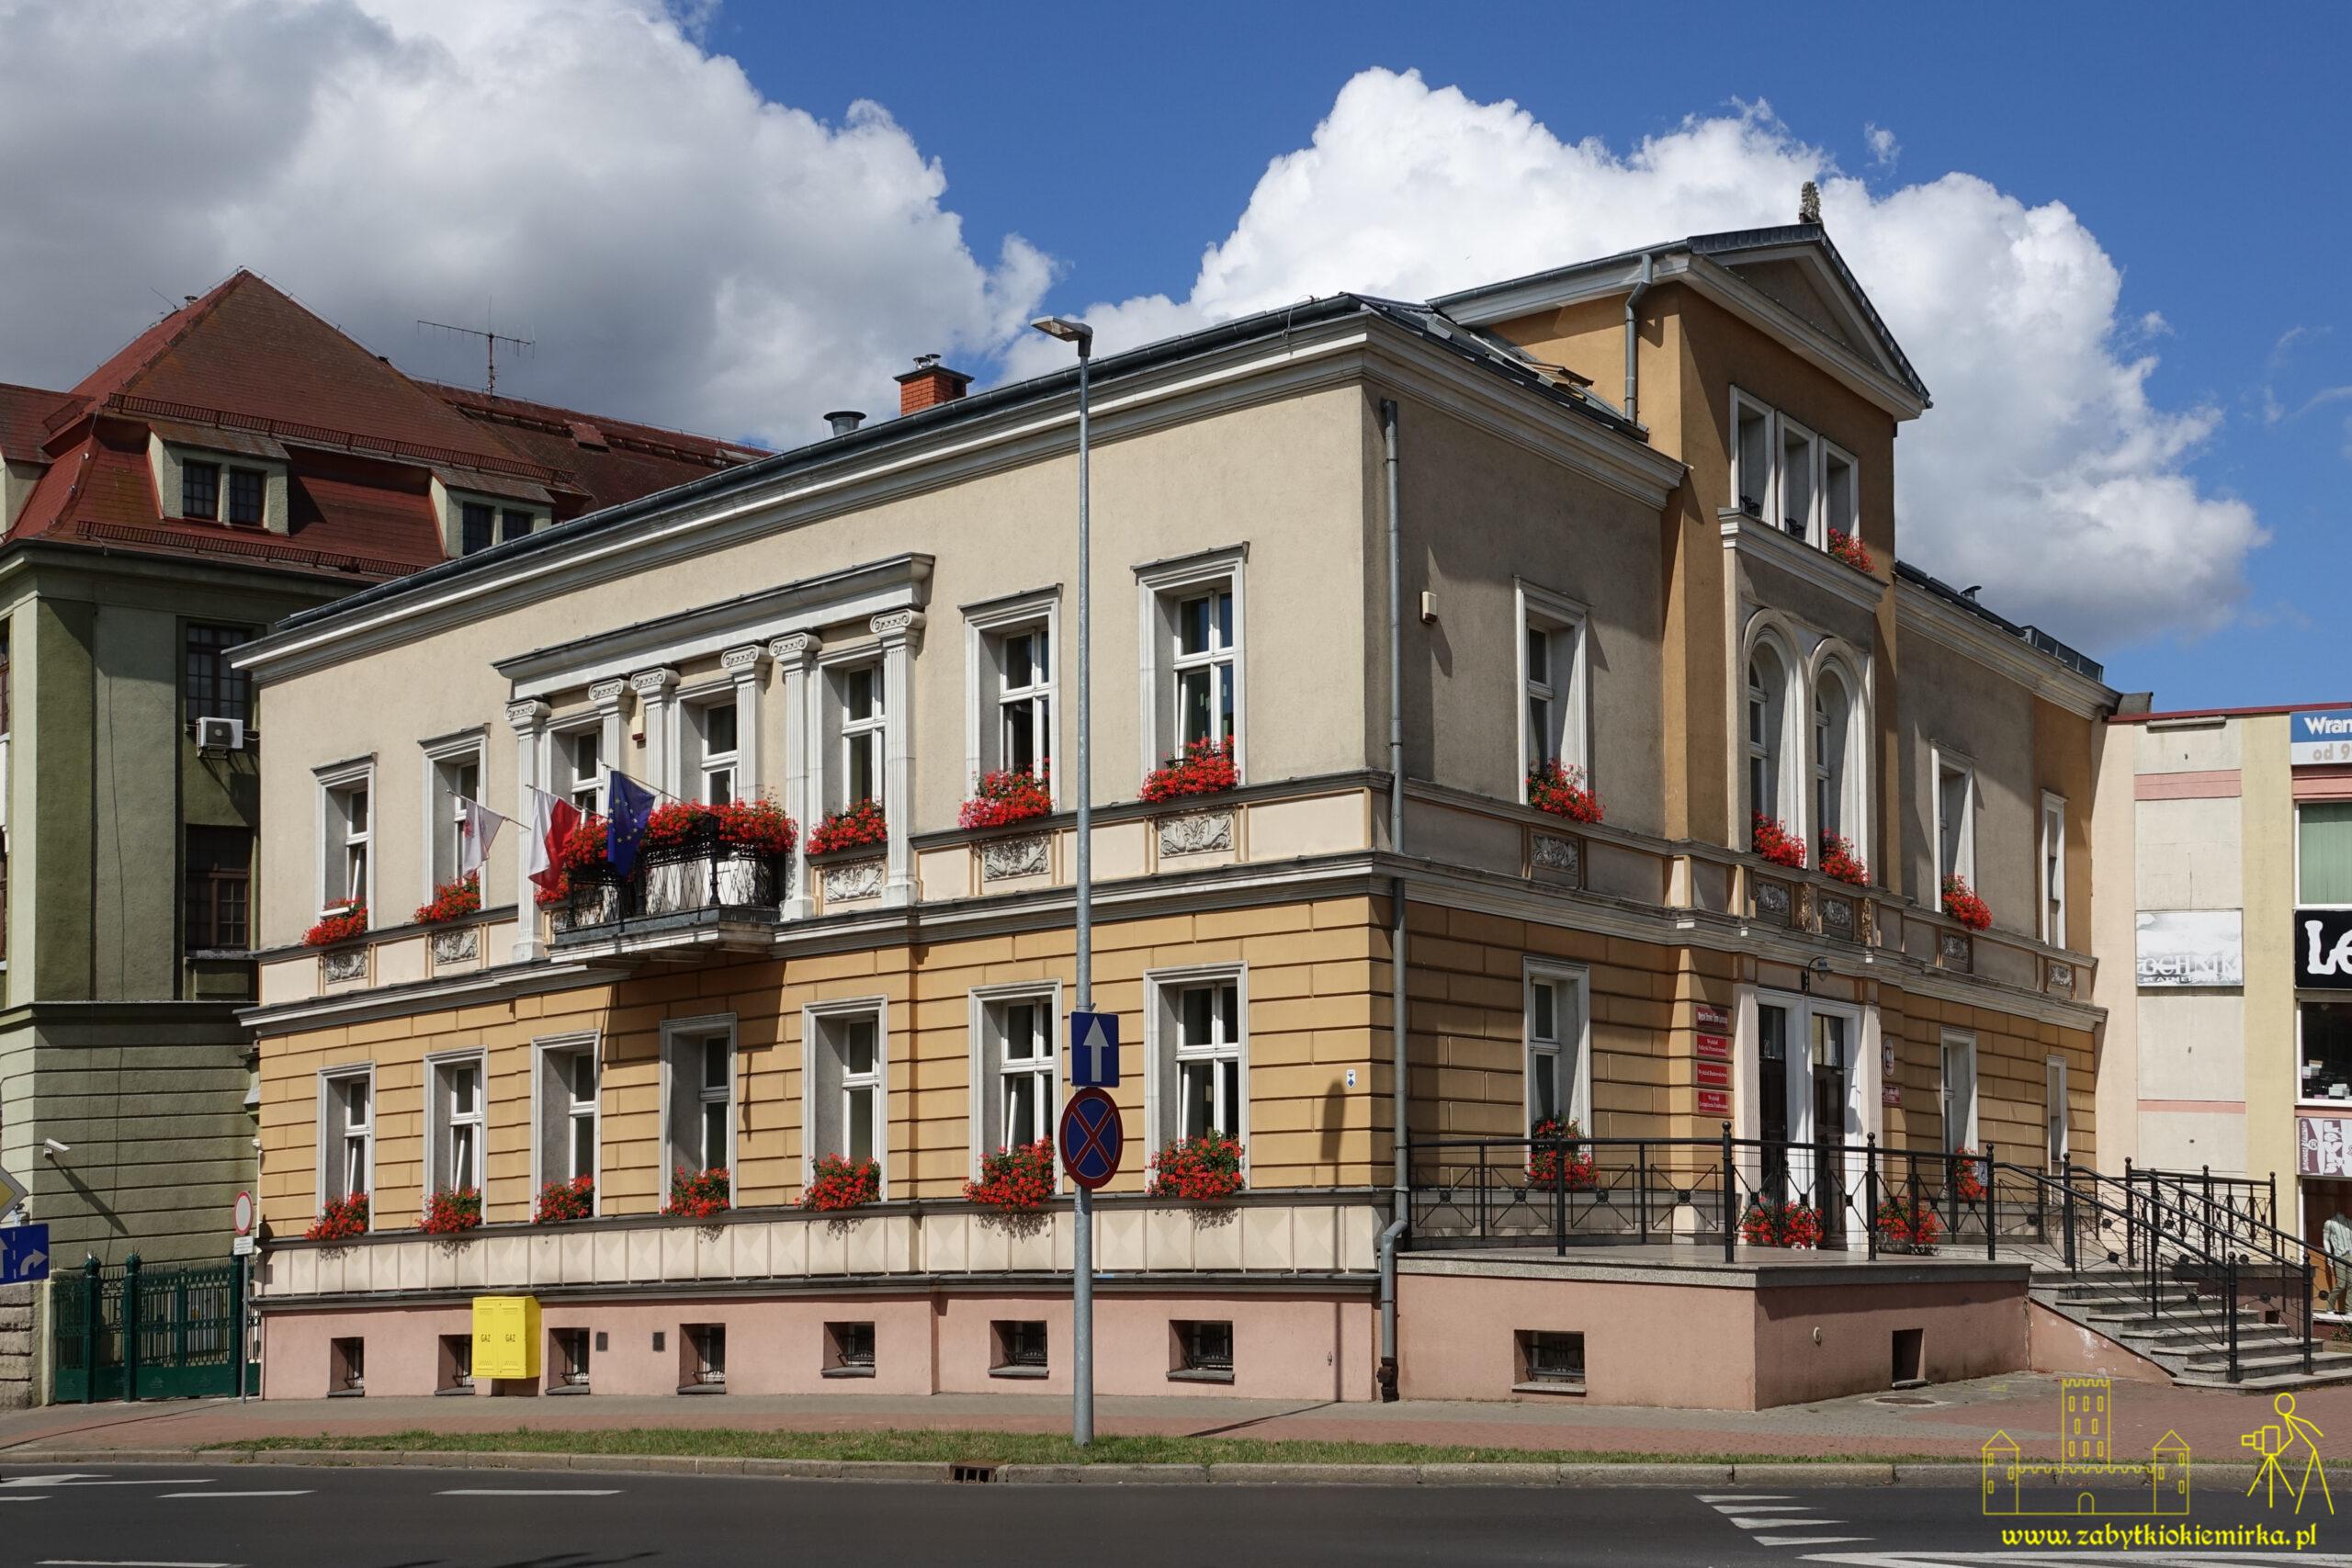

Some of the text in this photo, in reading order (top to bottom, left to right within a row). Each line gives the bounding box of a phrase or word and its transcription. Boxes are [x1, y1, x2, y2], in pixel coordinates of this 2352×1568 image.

[2312, 743, 2352, 761] od 9
[481, 1334, 492, 1342] GAZ
[505, 1334, 516, 1342] GAZ
